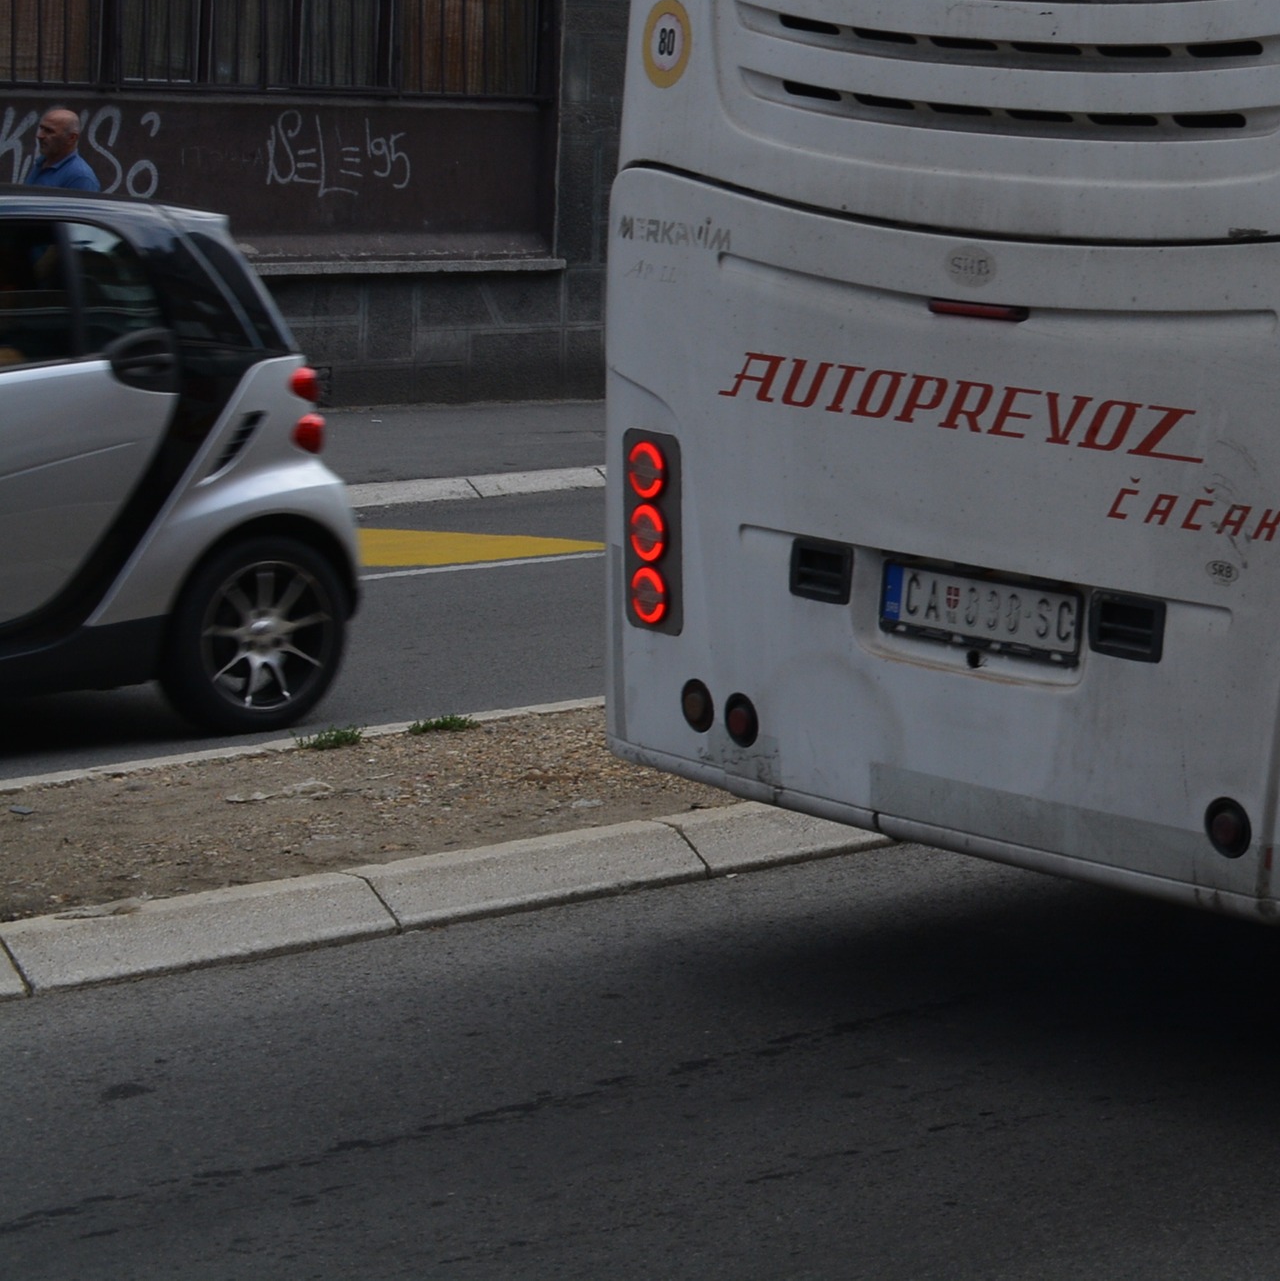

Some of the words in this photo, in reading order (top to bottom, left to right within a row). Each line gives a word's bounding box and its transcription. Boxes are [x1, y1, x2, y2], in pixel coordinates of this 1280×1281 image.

[658, 28, 675, 56] 80
[718, 352, 1204, 463] AUTOPREVOZ
[1212, 563, 1232, 578] SRB
